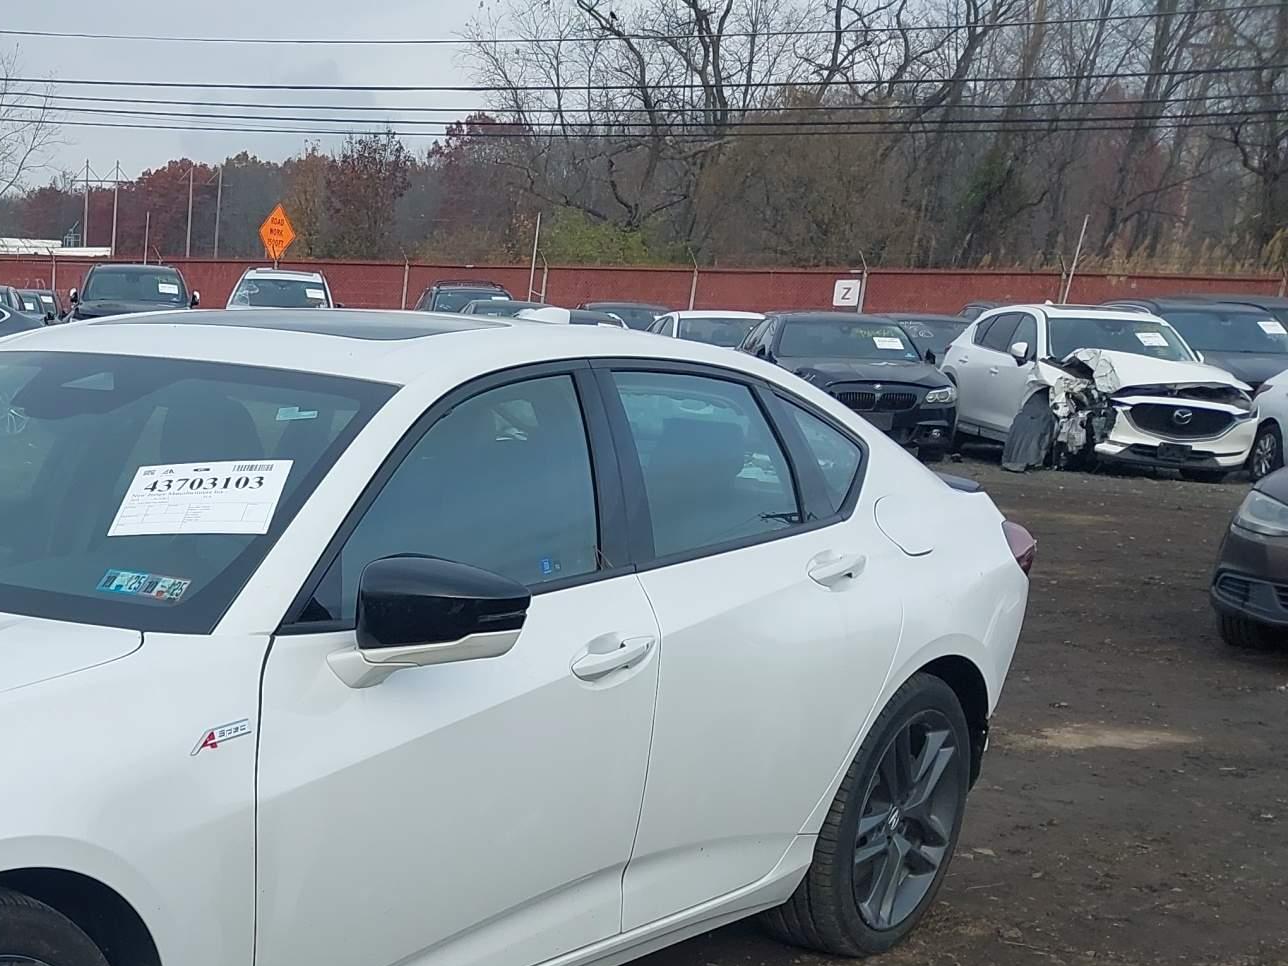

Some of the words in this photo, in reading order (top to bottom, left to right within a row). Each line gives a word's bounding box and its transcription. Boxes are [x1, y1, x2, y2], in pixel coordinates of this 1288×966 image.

[271, 217, 285, 226] ROAD
[269, 228, 284, 236] WORK
[841, 287, 852, 300] Z
[144, 476, 265, 493] 43703103
